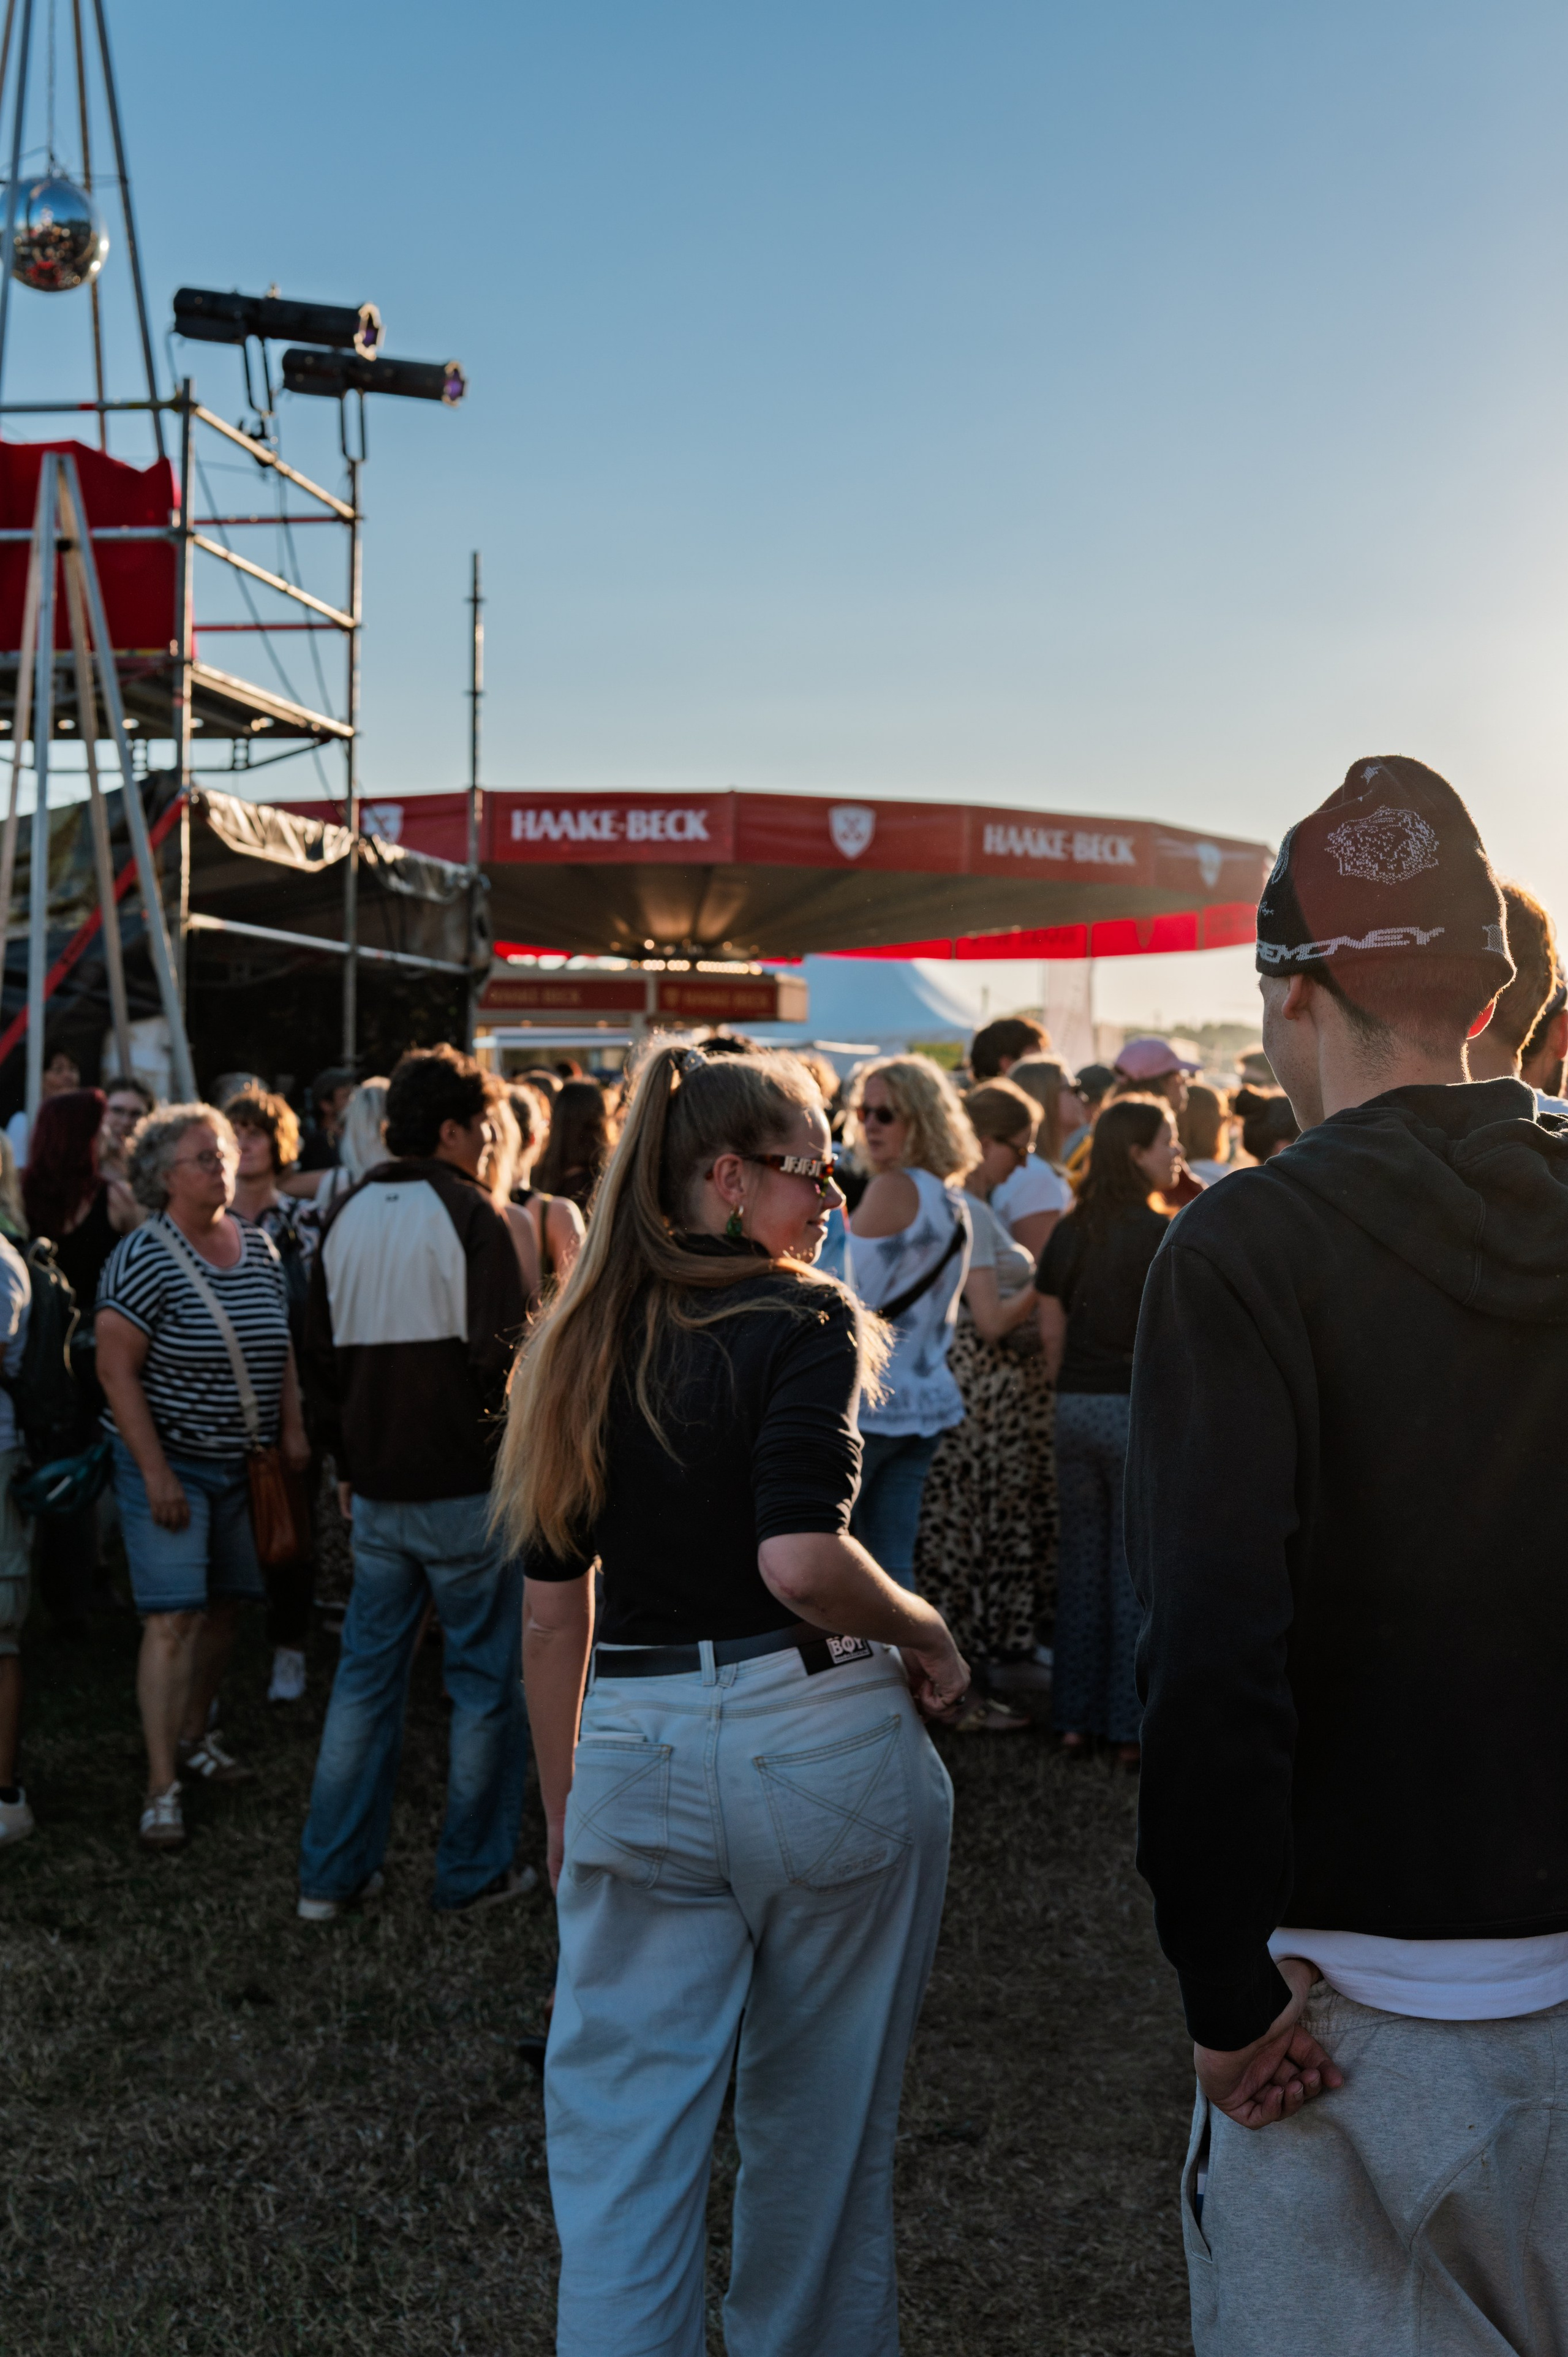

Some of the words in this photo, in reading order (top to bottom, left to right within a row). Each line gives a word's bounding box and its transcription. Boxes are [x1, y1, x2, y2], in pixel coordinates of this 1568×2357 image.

[511, 809, 709, 841] HAAKE-BECK
[984, 824, 1136, 865] HAAKE-BECK
[829, 1635, 864, 1656] BOY
